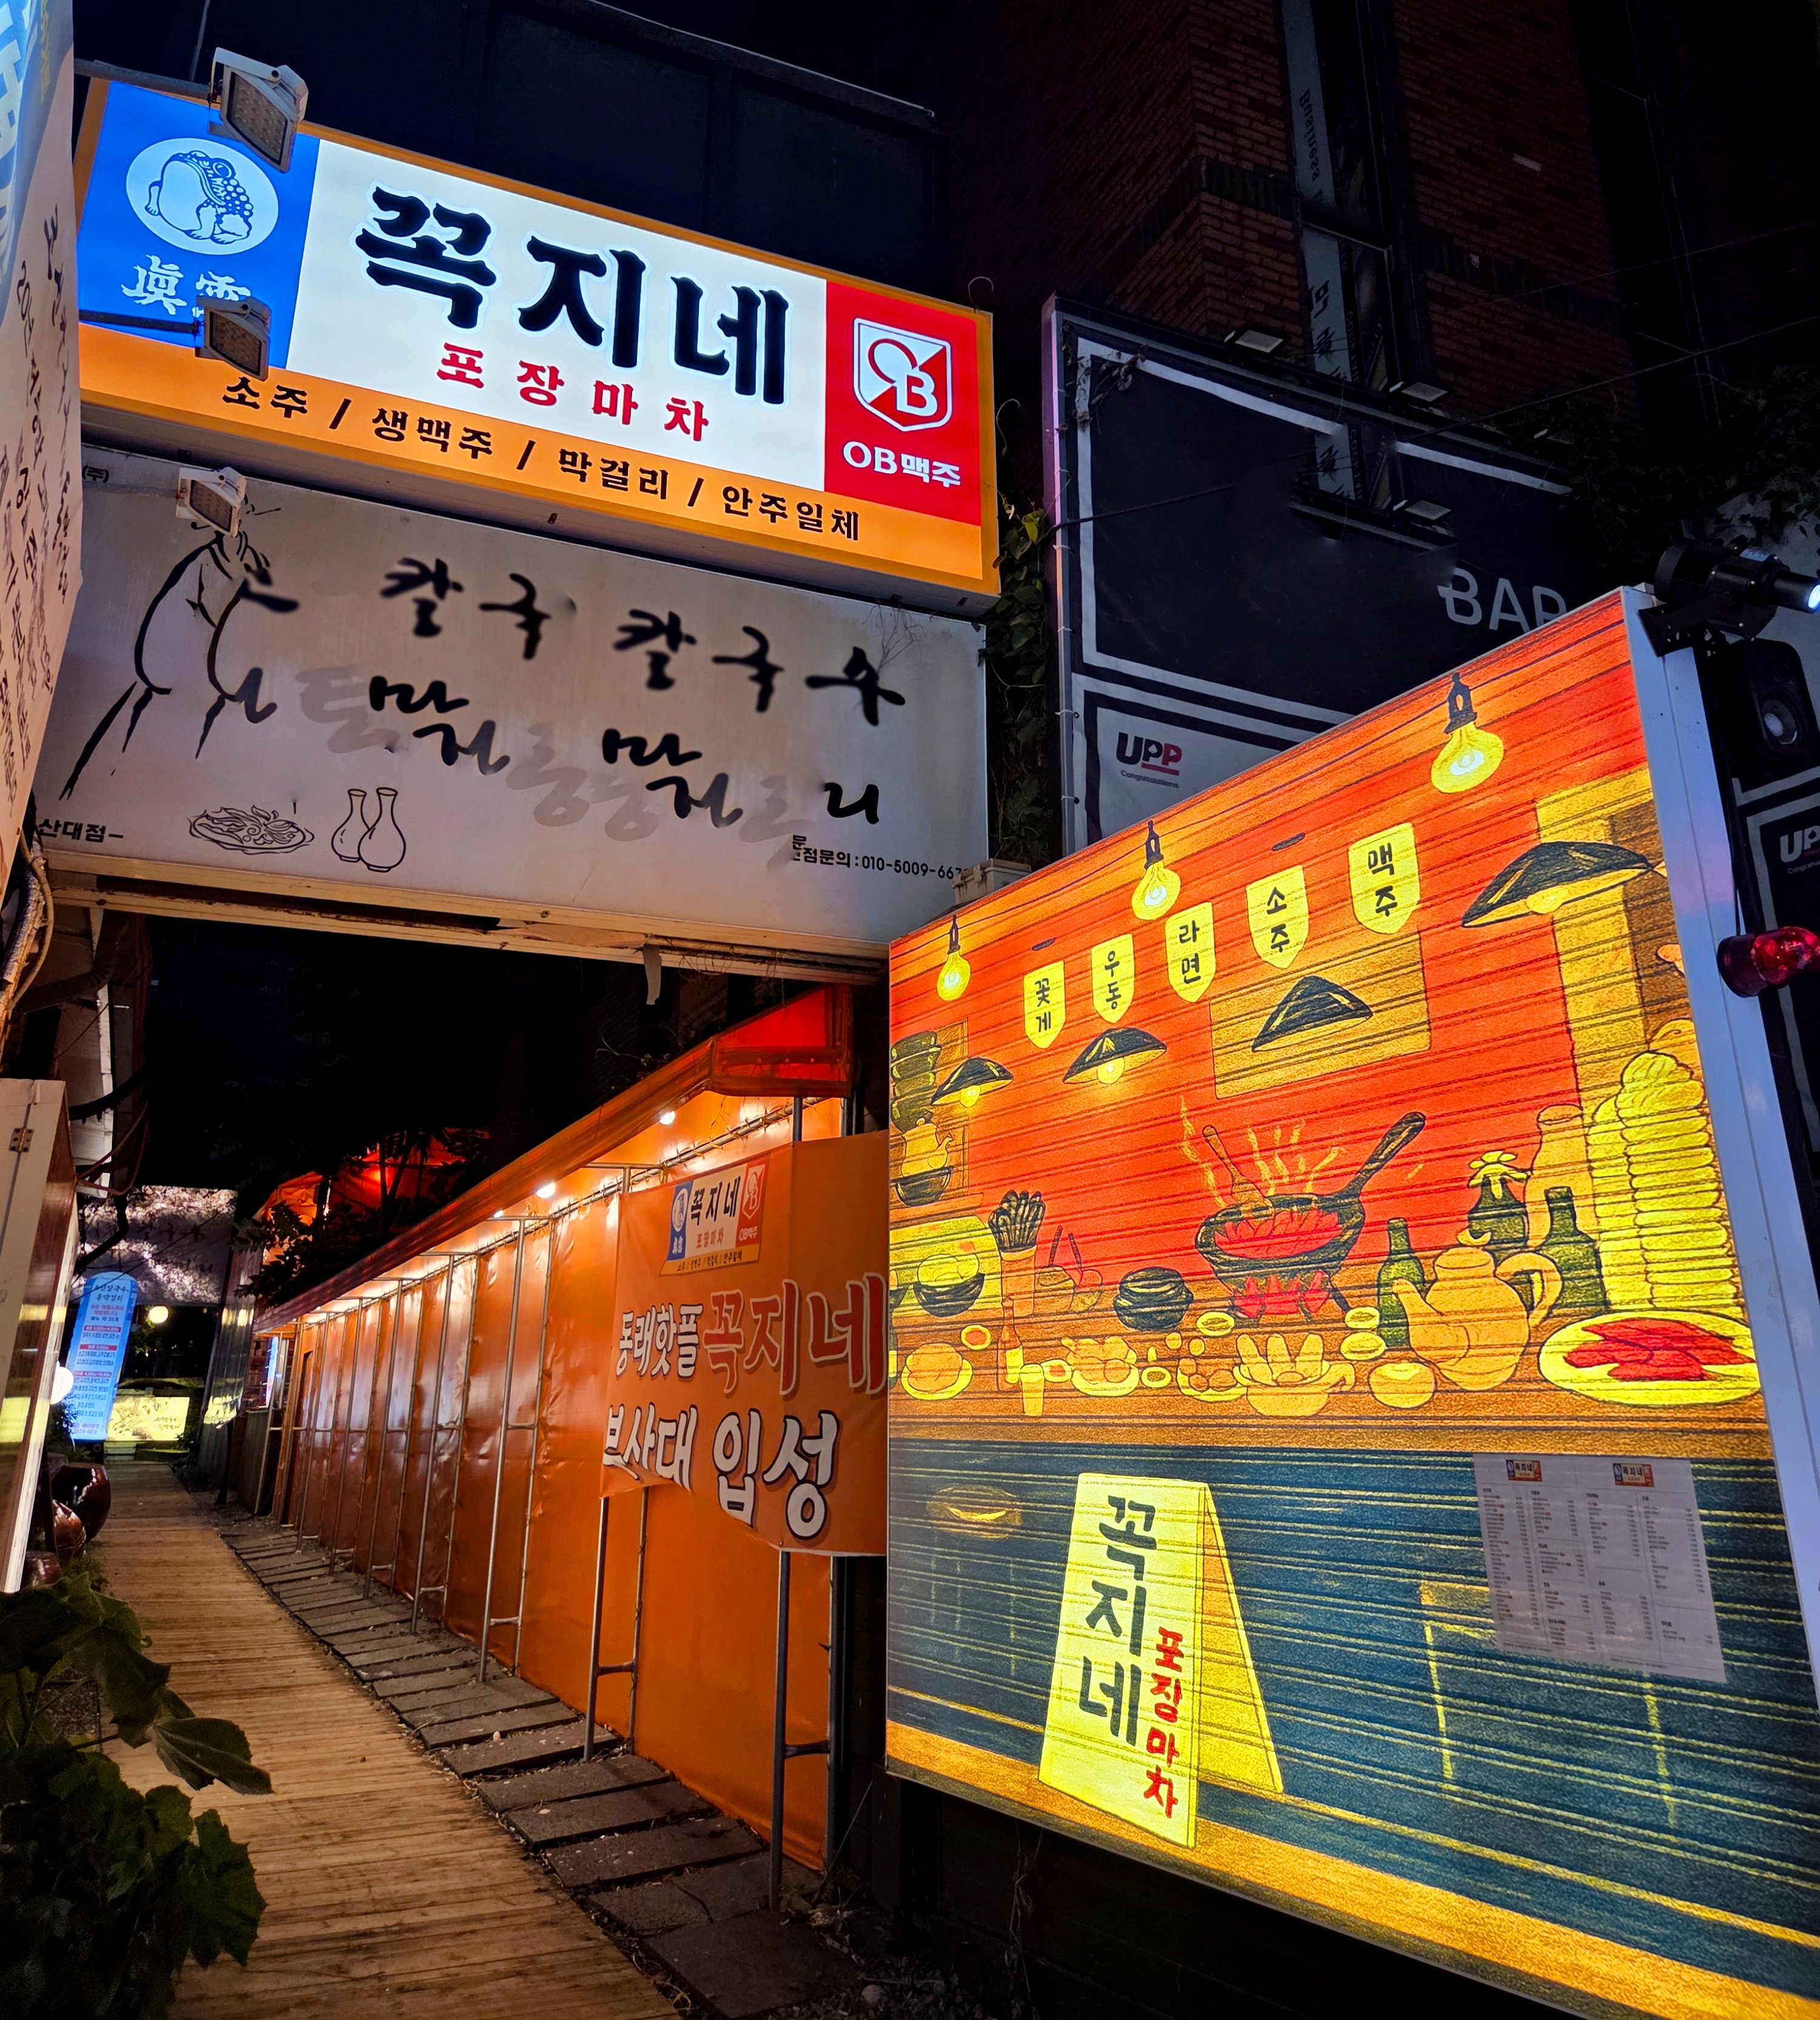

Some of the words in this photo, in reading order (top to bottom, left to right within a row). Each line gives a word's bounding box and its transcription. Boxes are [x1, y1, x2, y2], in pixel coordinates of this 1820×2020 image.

[356, 186, 790, 405] 꼭지네
[437, 342, 709, 442] 포장마차
[223, 376, 308, 418] 소주
[371, 407, 493, 459] 생맥주
[558, 448, 669, 499] 막걸리
[722, 485, 859, 541] 안주일체
[843, 441, 960, 488] OB맥주
[1116, 732, 1182, 766] UPP
[1367, 842, 1398, 919] 맥주
[1178, 919, 1202, 987] 라면
[1266, 887, 1291, 953] 소주
[1034, 978, 1053, 1033] 꽃게
[1104, 949, 1122, 1011] 우동
[690, 1175, 741, 1226] 꼭지네
[703, 1272, 891, 1396] 꼭지네
[713, 1408, 840, 1540] 입성
[1077, 1495, 1157, 1746] 꼭지네
[1144, 1626, 1184, 1819] 포장마차
